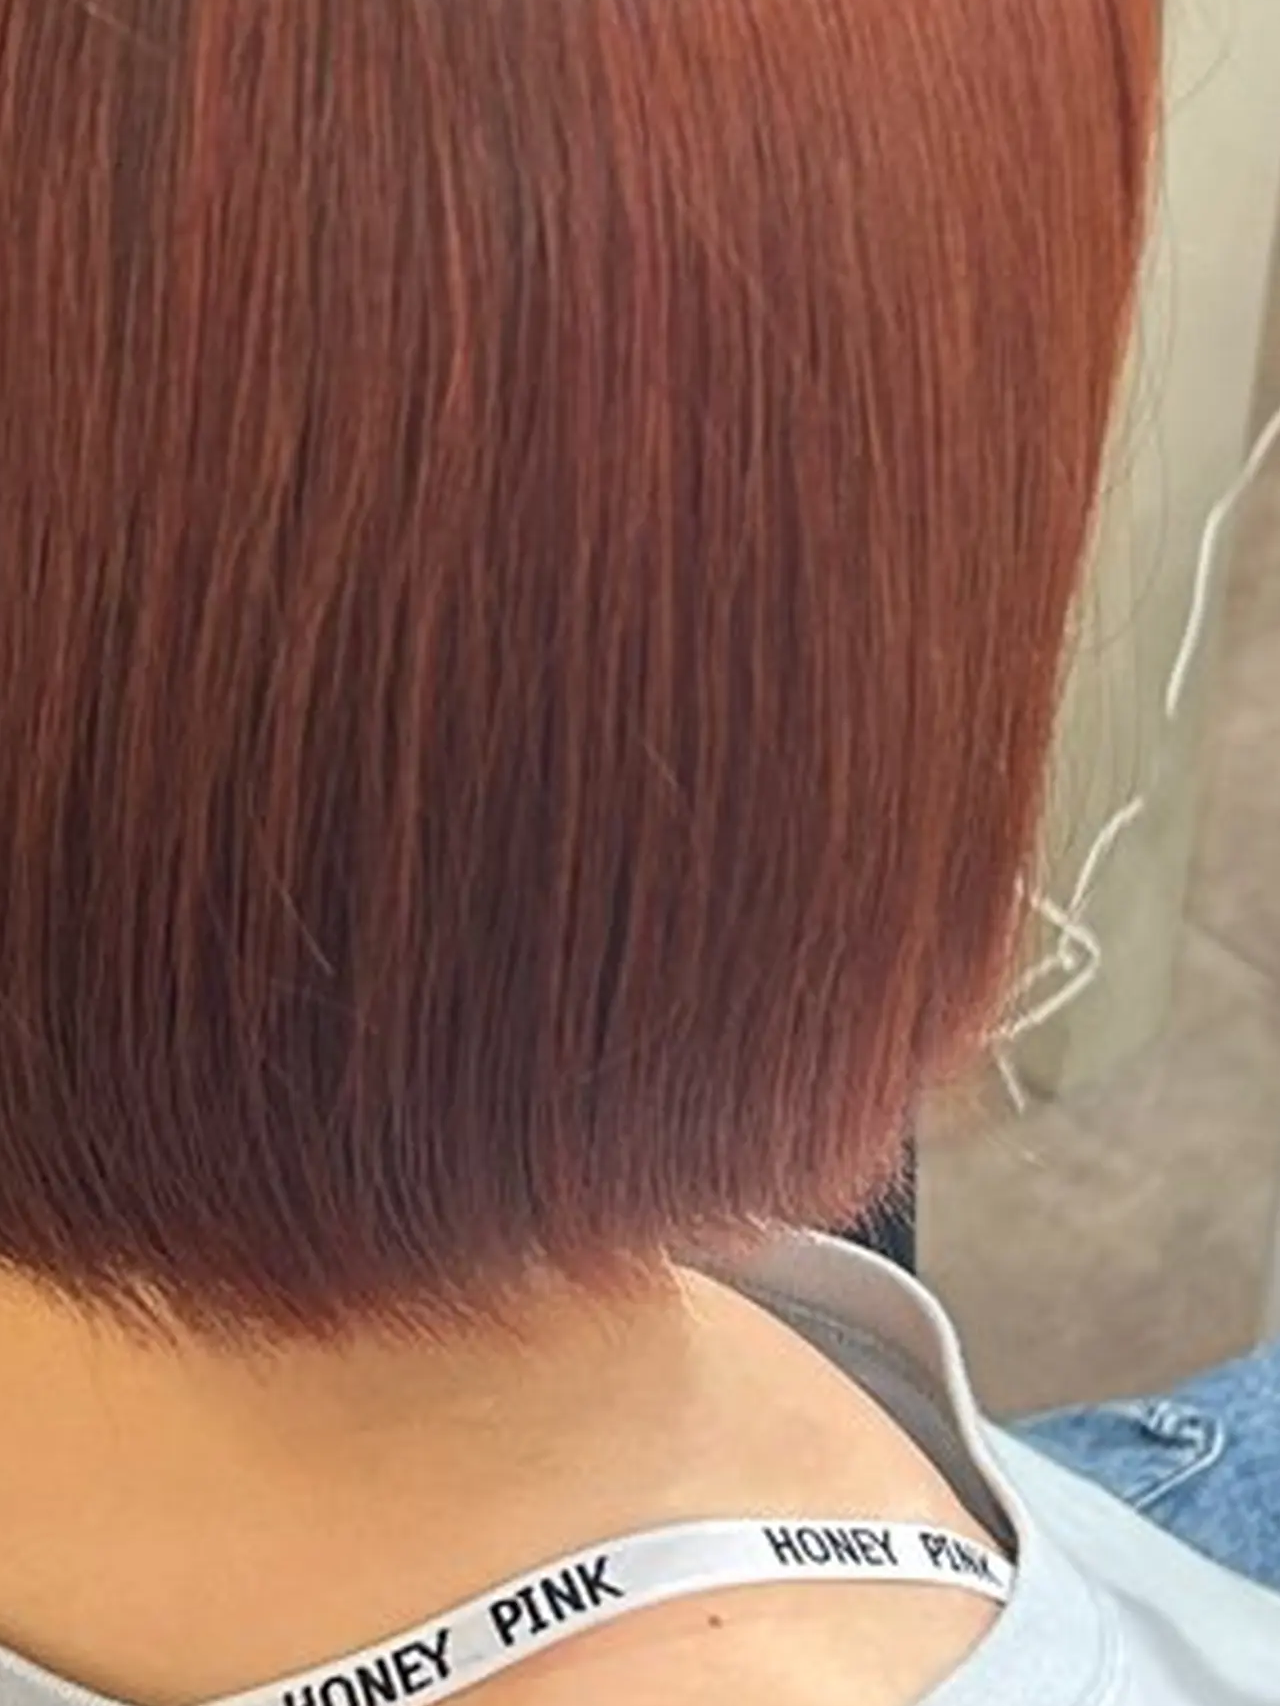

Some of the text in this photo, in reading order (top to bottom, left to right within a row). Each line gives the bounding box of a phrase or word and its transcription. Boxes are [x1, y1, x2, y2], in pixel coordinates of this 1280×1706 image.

[488, 1554, 625, 1647] PINK
[761, 1525, 899, 1566] HONEY
[919, 1530, 1005, 1588] PINK
